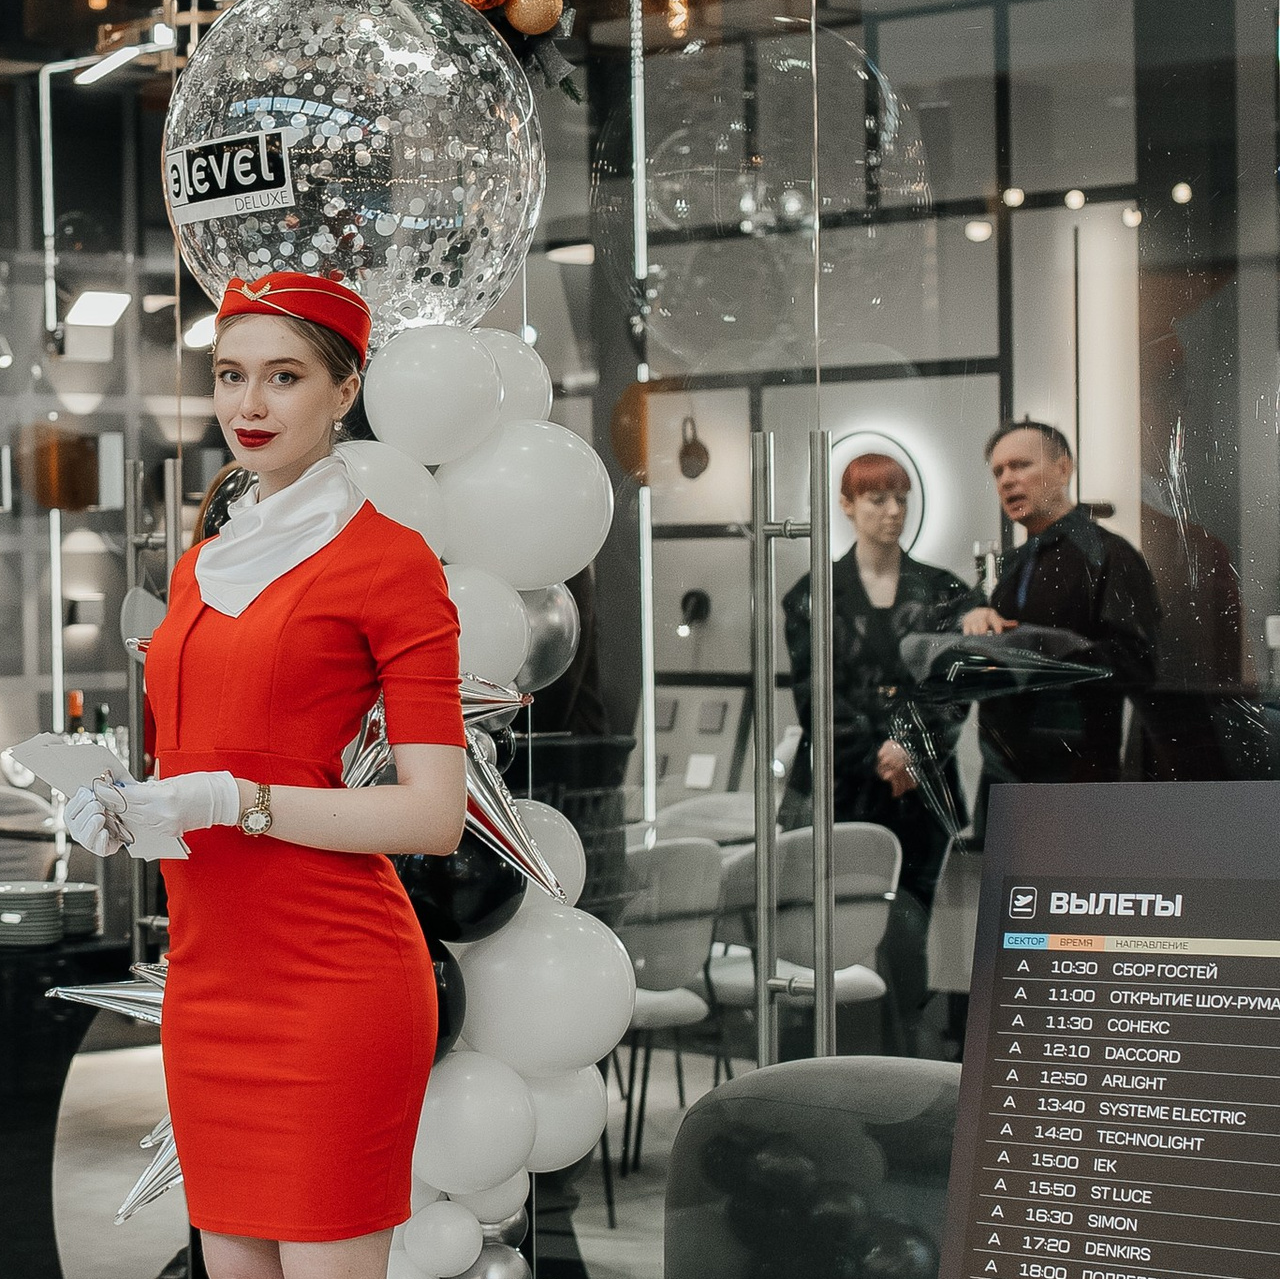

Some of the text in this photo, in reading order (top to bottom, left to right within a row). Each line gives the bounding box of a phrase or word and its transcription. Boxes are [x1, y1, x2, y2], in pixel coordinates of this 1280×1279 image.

[235, 190, 289, 212] DELUXE
[1049, 891, 1183, 917] ВЫЛЕТЫ
[1007, 936, 1189, 950] СЕКТОР ВРЕМЯ НАПРАВЛЕНИЕ
[1051, 960, 1098, 975] 10:30
[1112, 962, 1155, 977] СБОР
[1157, 963, 1218, 980] ГОСТЕЙ
[1048, 988, 1096, 1003] 11:00
[1109, 990, 1193, 1007] ОТКРЫТИЕ
[1196, 994, 1280, 1010] ШОУ-РУМА
[1045, 1015, 1093, 1031] 11:30
[1107, 1019, 1170, 1035] СОНЕКС
[1043, 1043, 1091, 1058] 12:10
[1105, 1046, 1181, 1064] DACCORD
[1040, 1070, 1088, 1086] 12:50
[1101, 1074, 1167, 1091] ARLIGHT
[1037, 1097, 1086, 1113] 13:40
[1099, 1102, 1169, 1120] SYSTEME
[1172, 1107, 1247, 1126] ELECTRIC
[1034, 1125, 1083, 1141] 14:20
[1097, 1129, 1205, 1151] TECHNOLIGHT
[1031, 1153, 1079, 1169] 15:00
[1093, 1158, 1117, 1173] IEK
[1028, 1180, 1076, 1197] 15:50
[1025, 1207, 1073, 1225] 16:30
[1087, 1214, 1138, 1231] SIMON
[1022, 1235, 1070, 1253] 17:20
[1085, 1241, 1151, 1261] DENKIRS
